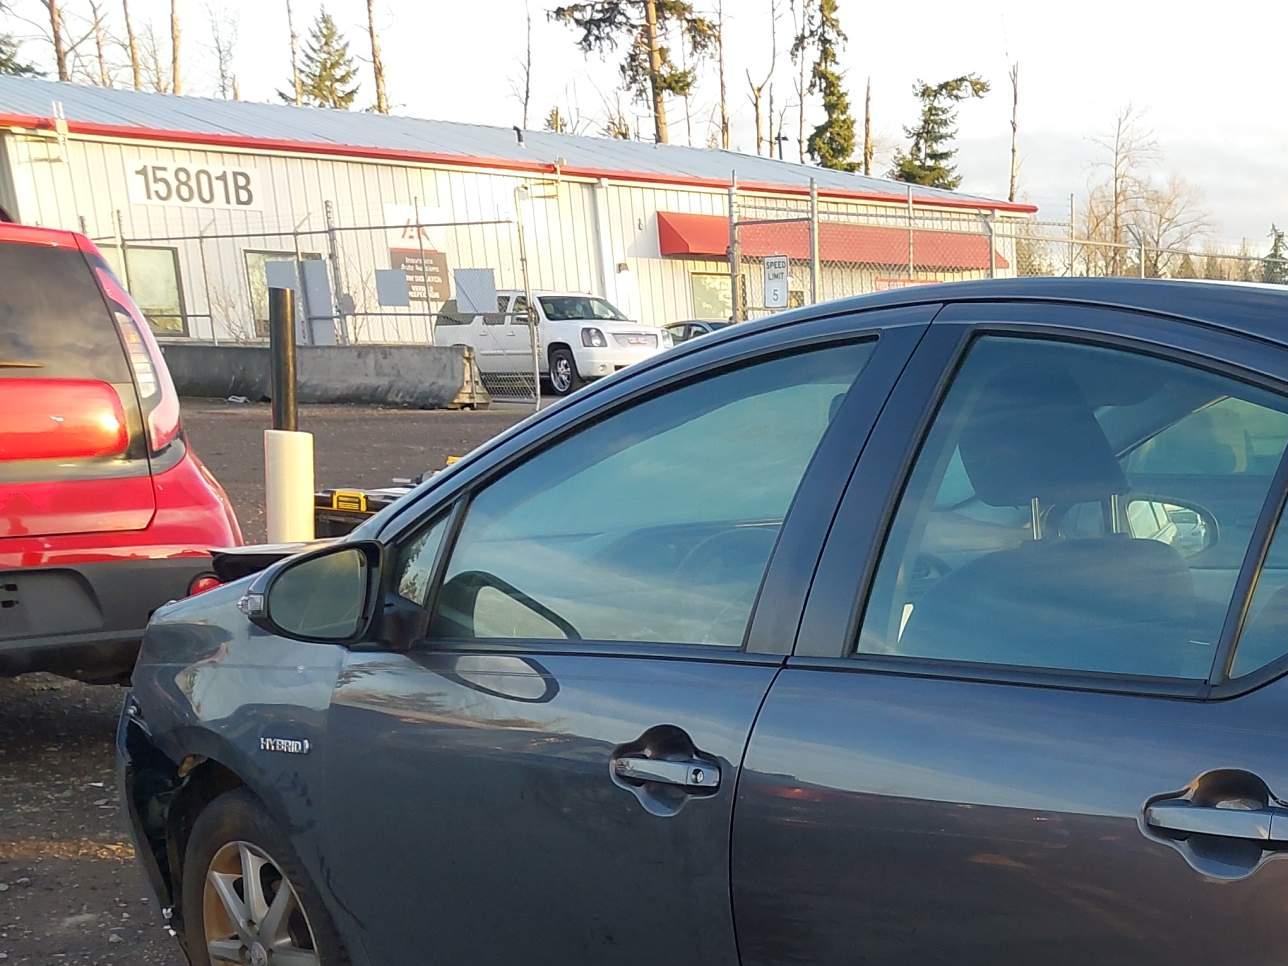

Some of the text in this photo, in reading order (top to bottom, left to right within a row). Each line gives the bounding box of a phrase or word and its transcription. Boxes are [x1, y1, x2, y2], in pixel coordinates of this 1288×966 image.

[135, 165, 253, 205] 15801B
[767, 261, 785, 269] SPEED
[768, 272, 784, 280] LIMIT
[773, 289, 779, 301] 5
[260, 737, 302, 753] HYBRID
